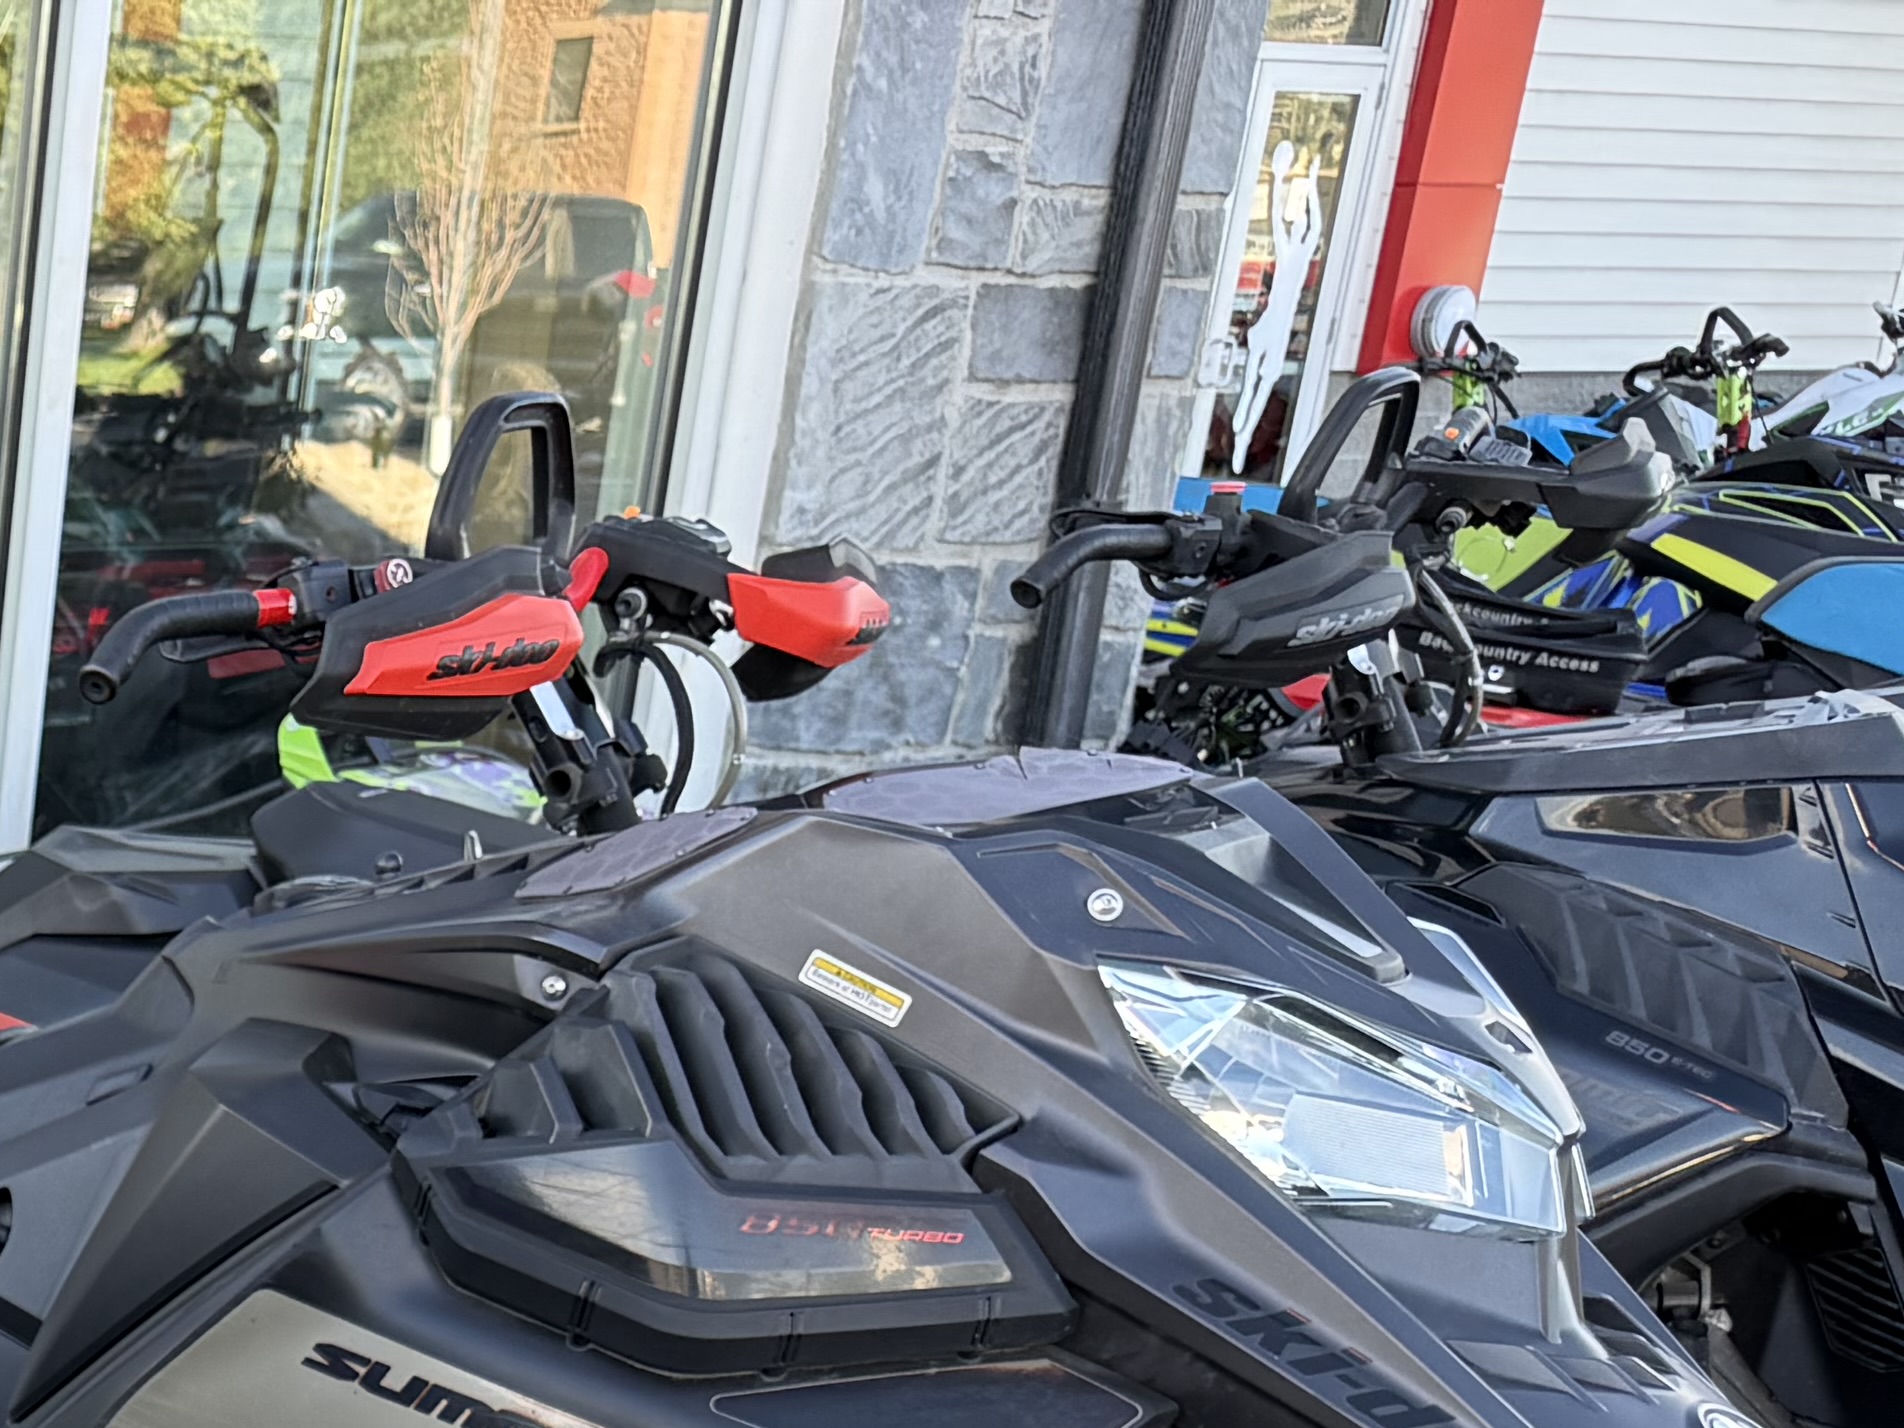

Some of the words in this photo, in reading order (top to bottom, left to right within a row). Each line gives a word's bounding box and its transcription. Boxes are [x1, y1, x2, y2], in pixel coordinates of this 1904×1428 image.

[1536, 652, 1600, 674] Access
[1605, 1030, 1669, 1065] 850
[867, 1226, 965, 1245] TURBO
